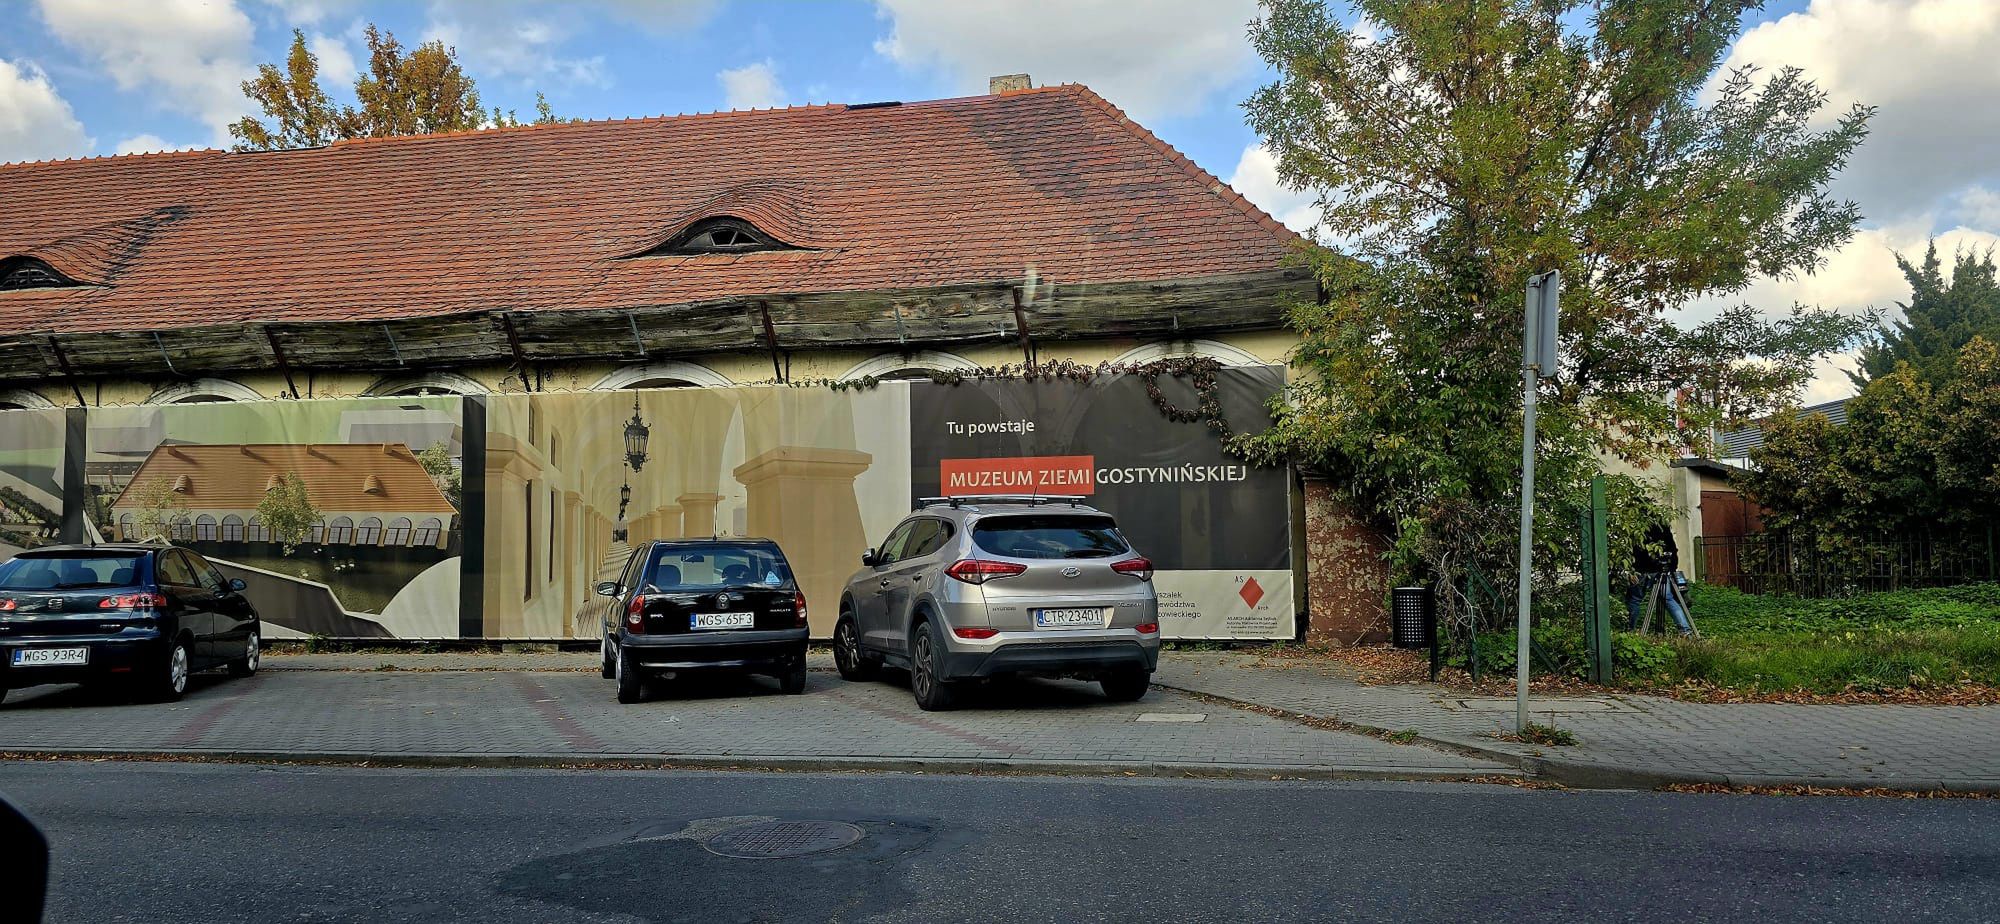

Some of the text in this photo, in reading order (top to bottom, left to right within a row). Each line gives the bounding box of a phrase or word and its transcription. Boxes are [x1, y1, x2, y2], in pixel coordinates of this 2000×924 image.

[945, 419, 1035, 438] Tu powstaje
[950, 463, 1248, 488] MUZEUM ZIEMI GOSTYNIŃSKIEJ
[1157, 600, 1196, 608] ewództwa
[697, 613, 753, 626] WGS 65F3
[1043, 609, 1099, 622] CTR 23401
[24, 649, 84, 662] WGS 93R4
